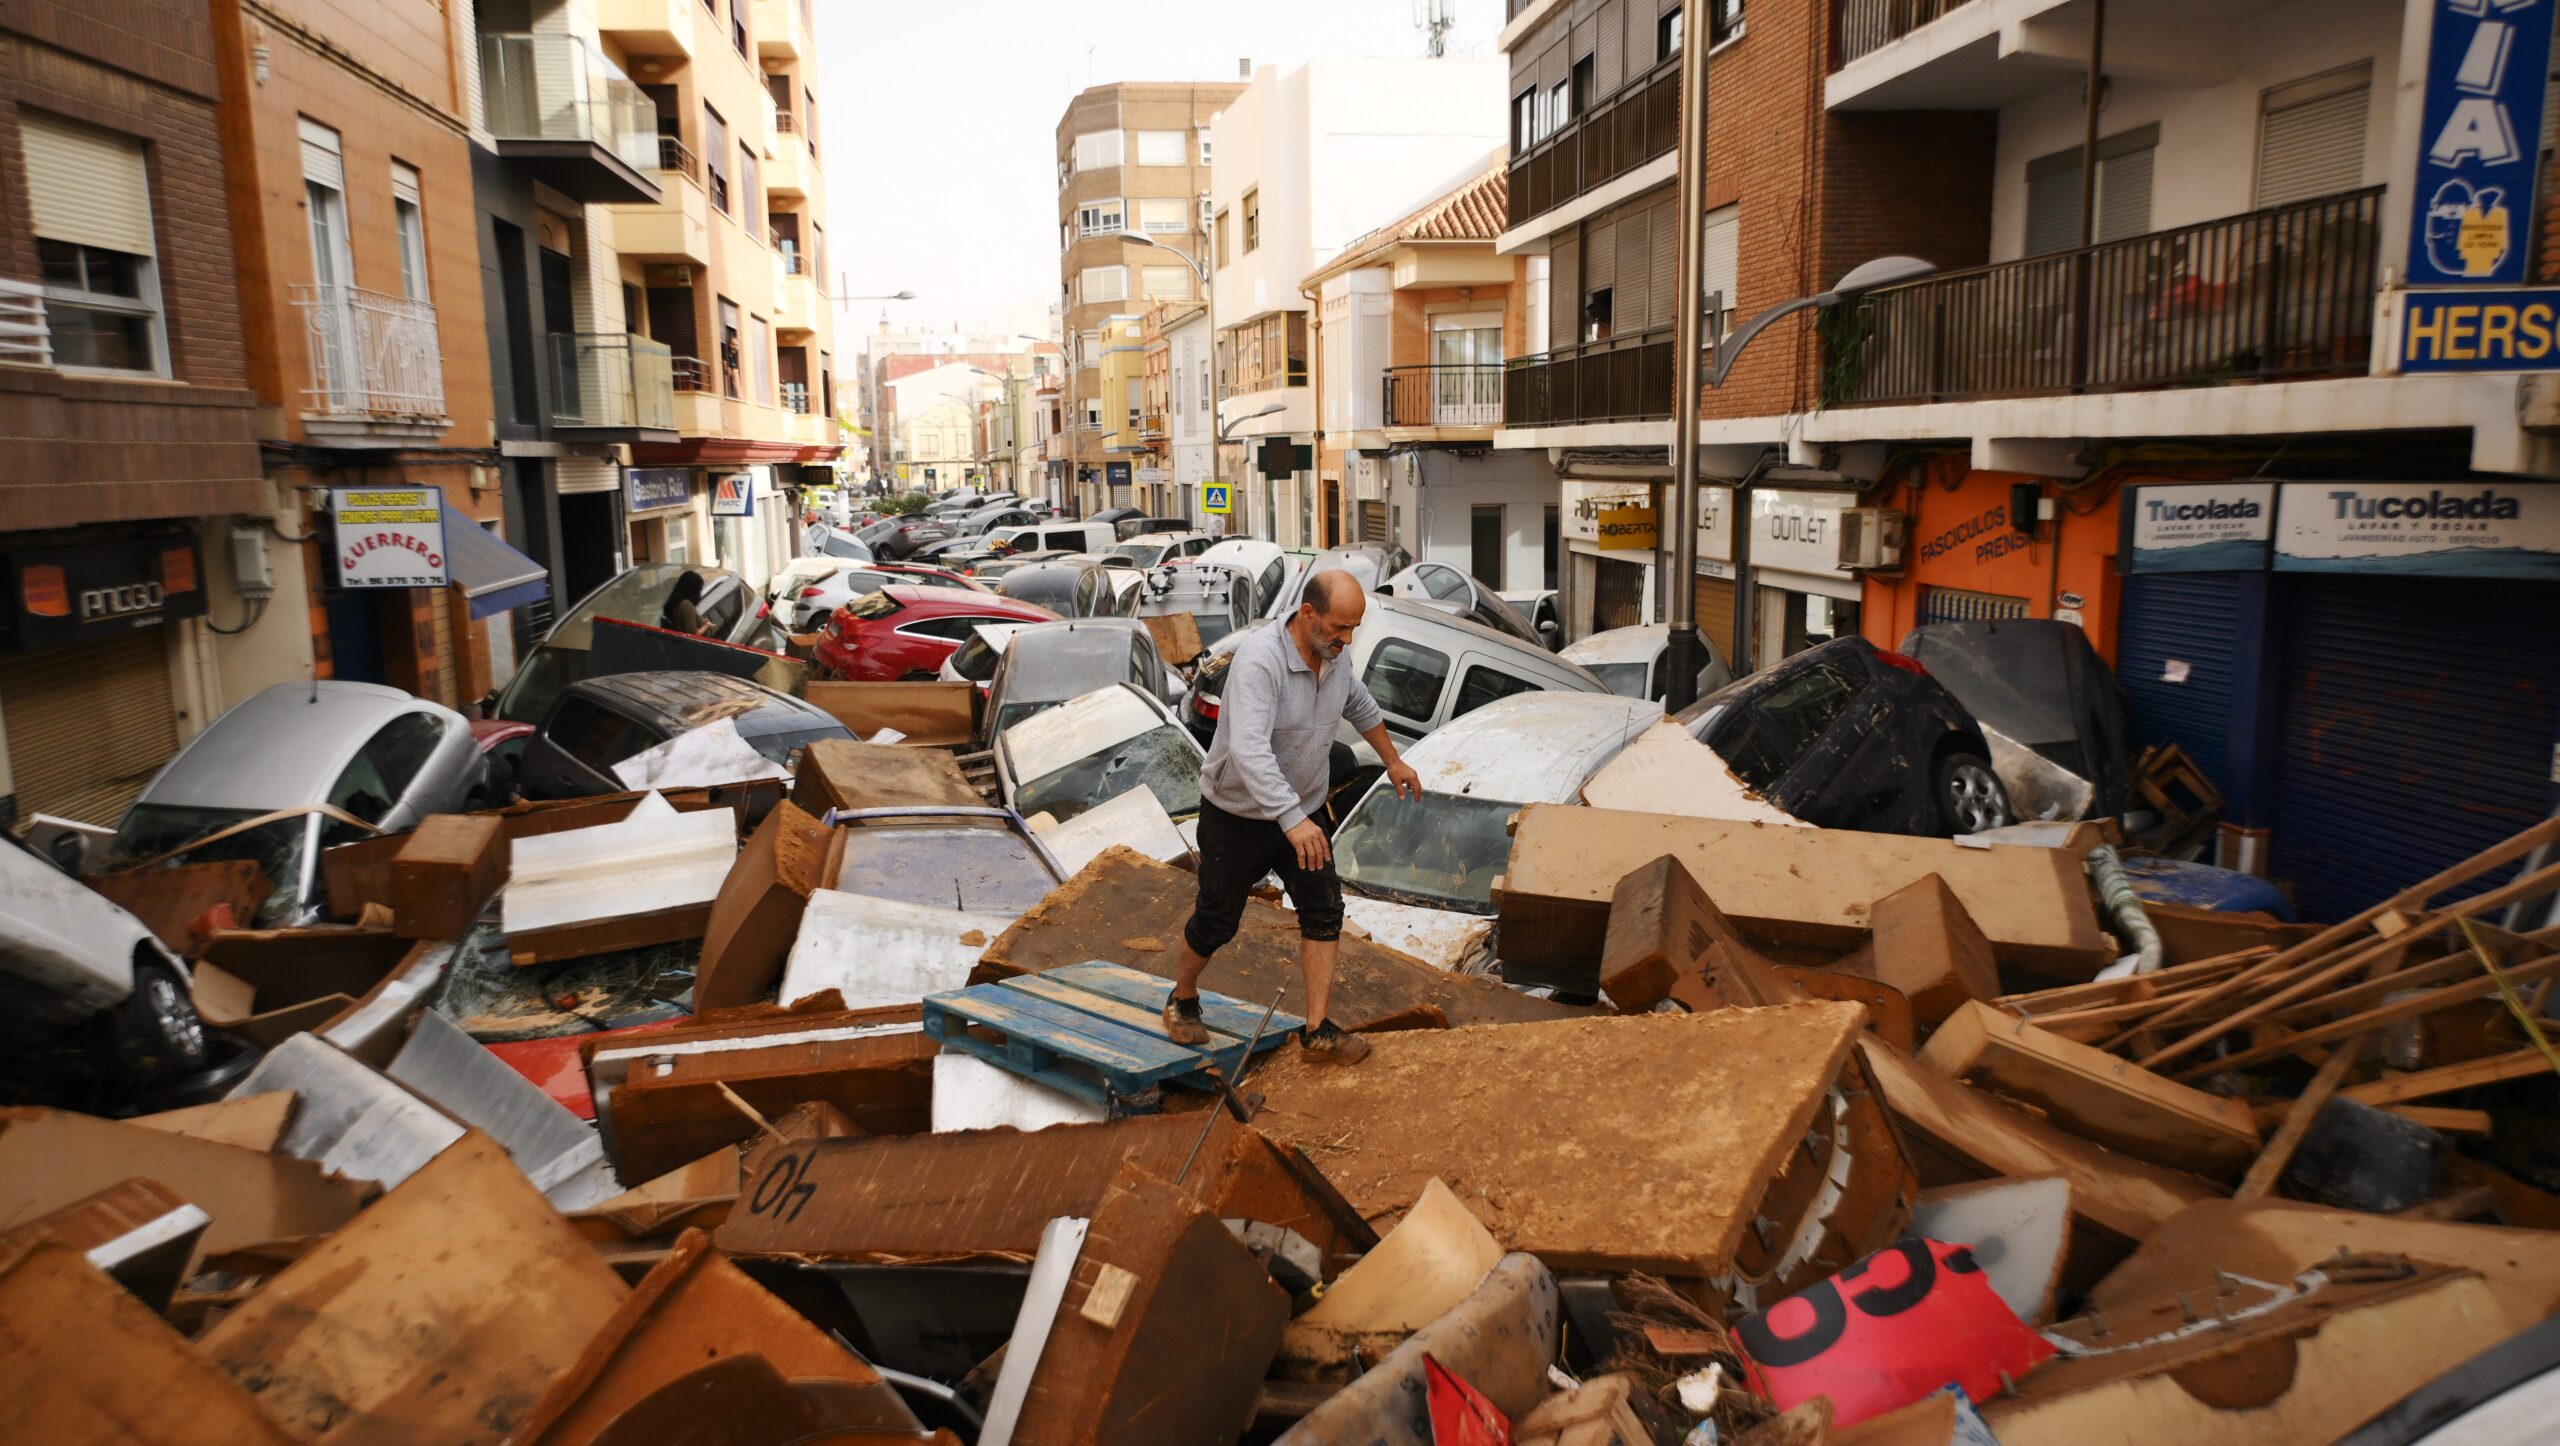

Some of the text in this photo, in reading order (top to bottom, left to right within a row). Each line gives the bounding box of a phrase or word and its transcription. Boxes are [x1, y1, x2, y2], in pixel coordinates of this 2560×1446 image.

[2405, 303, 2560, 361] HERS
[347, 492, 380, 506] POLLOS
[382, 492, 417, 506] ASADOS
[2329, 490, 2520, 519] Tucolada
[379, 510, 403, 524] PARA
[404, 509, 439, 523] LLEVAR
[2145, 498, 2260, 522] Tucolada
[1597, 522, 1657, 537] ROBERTA
[1772, 514, 1827, 545] OUTLET
[2157, 524, 2192, 532] LAVAR
[2209, 522, 2245, 530] SECAR
[2347, 522, 2488, 531] LAVAR Y SECAR
[1920, 504, 2005, 566] FASCICULOS
[2407, 535, 2437, 543] AUTO
[2448, 536, 2500, 544] SERVICIO
[342, 532, 443, 570] GUERRERO
[346, 577, 366, 585] Tel.
[369, 577, 384, 585] 96
[412, 576, 426, 584] 70
